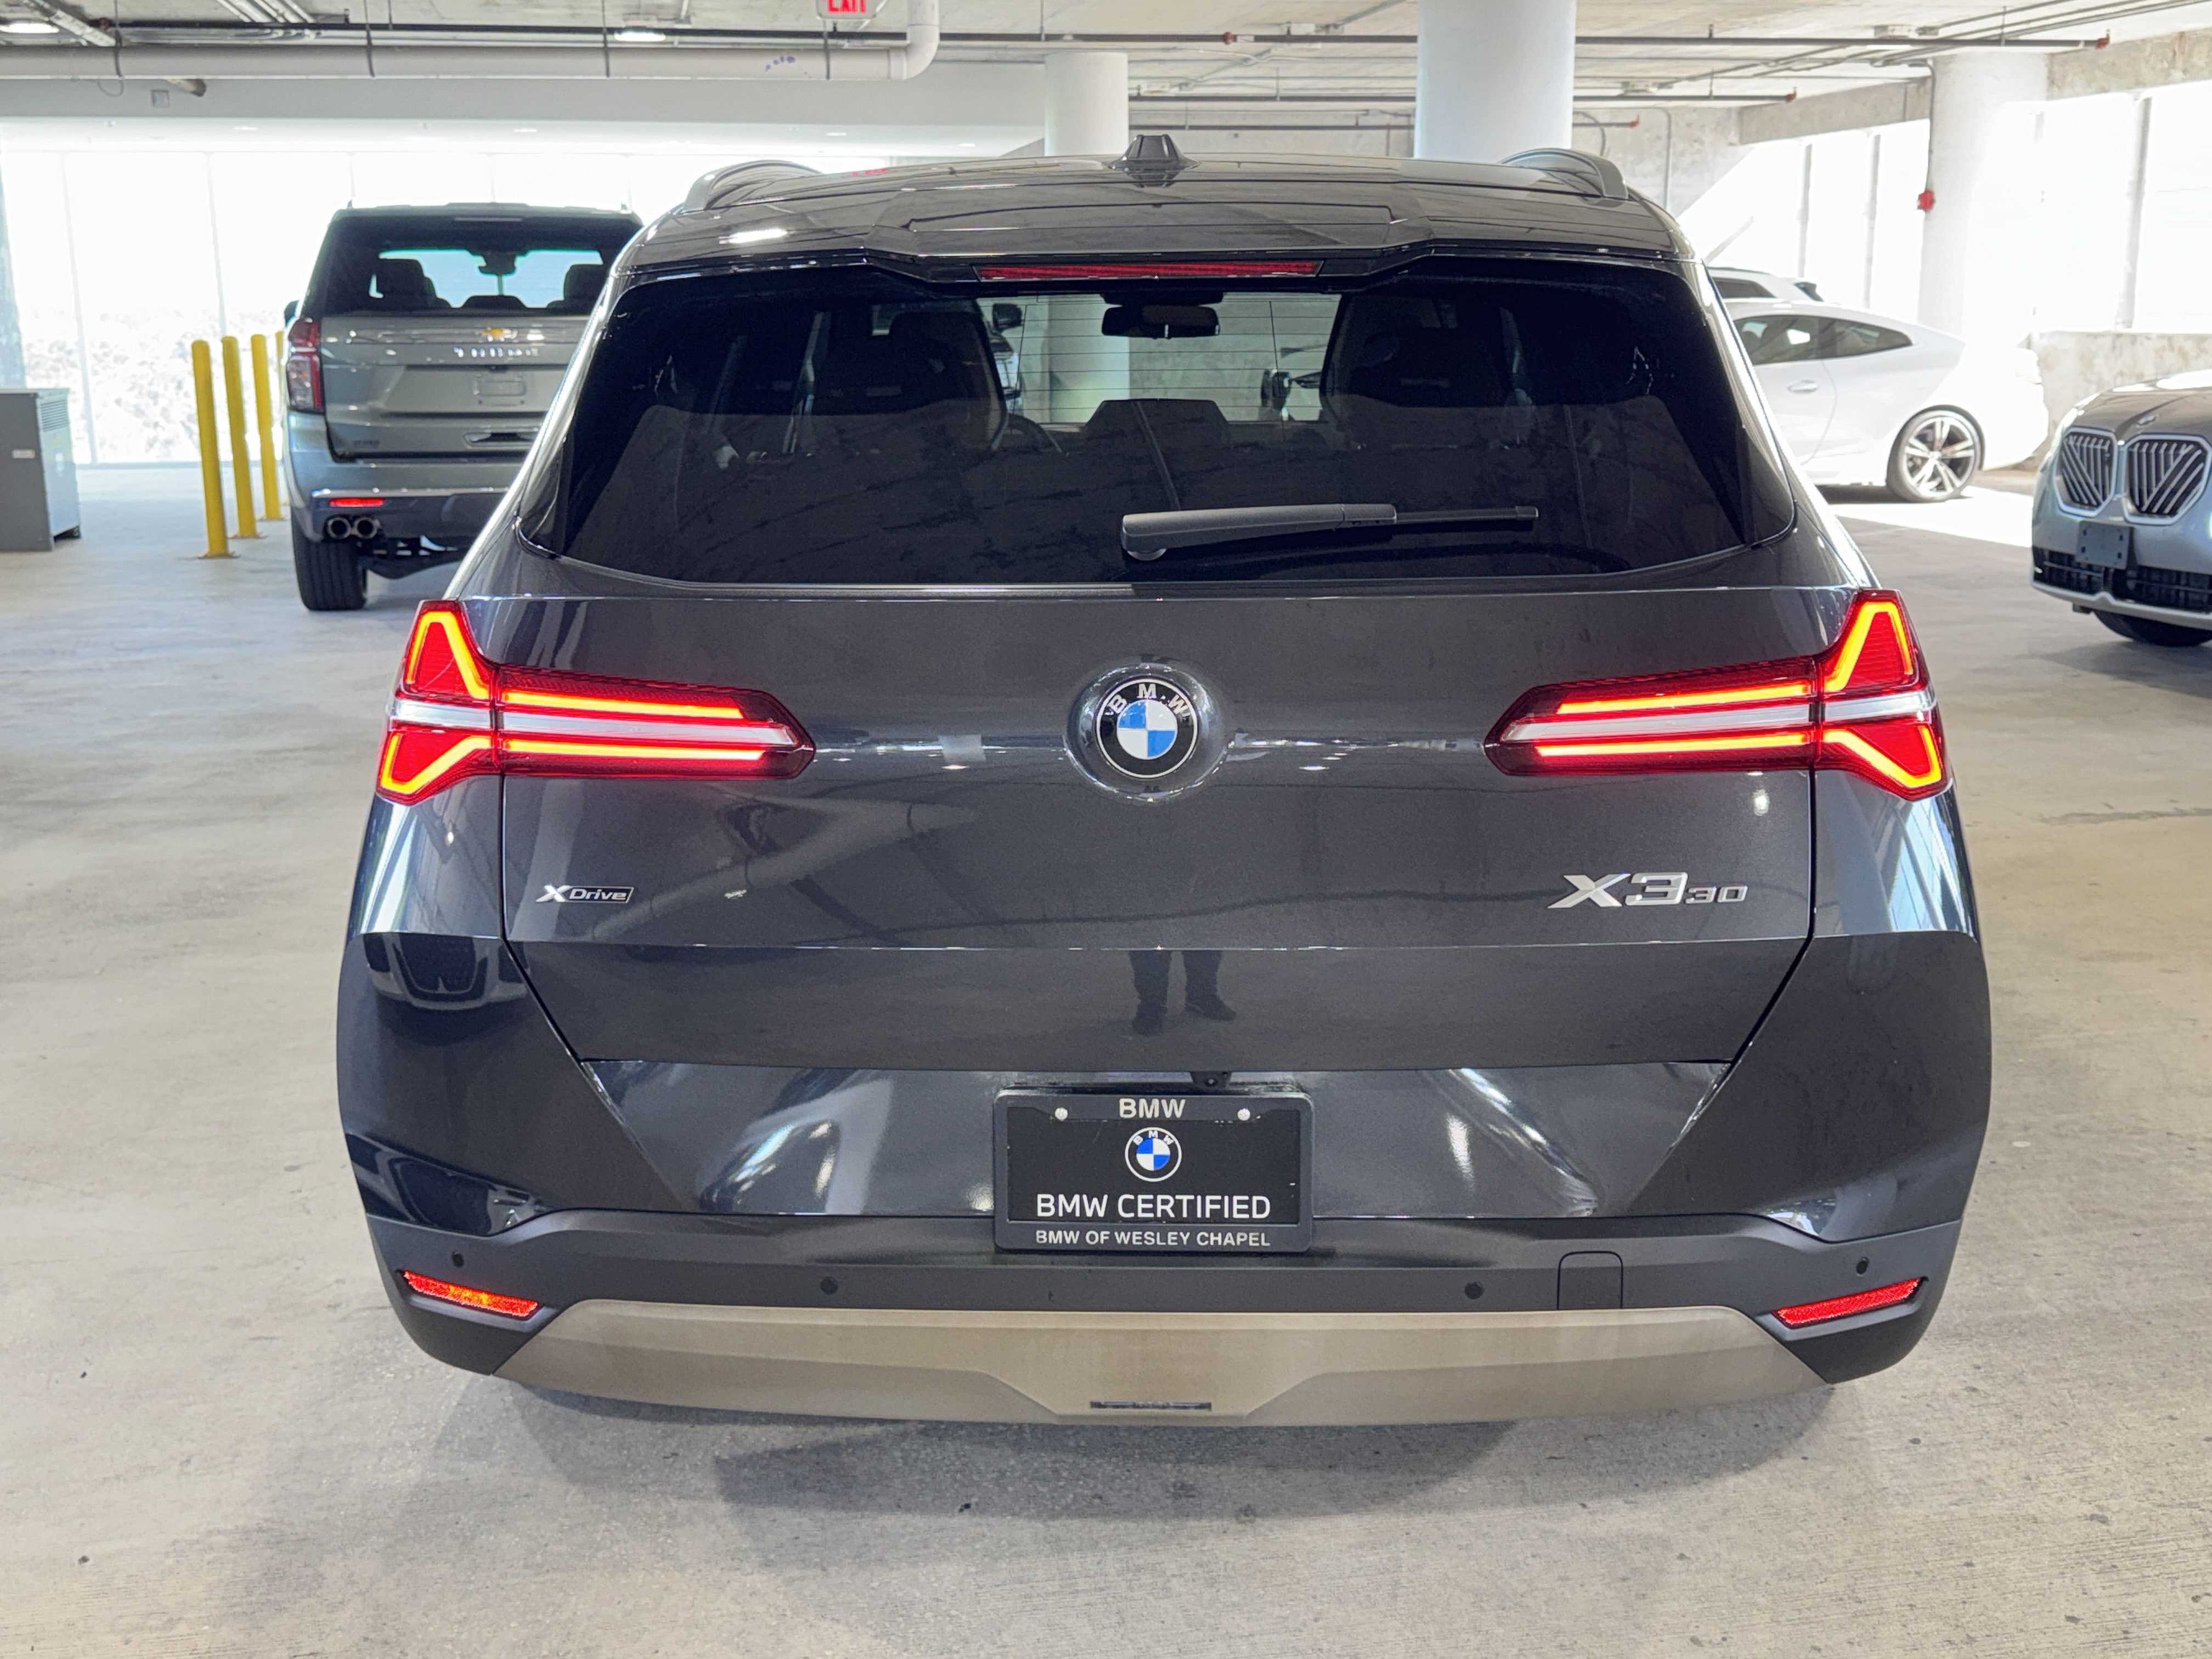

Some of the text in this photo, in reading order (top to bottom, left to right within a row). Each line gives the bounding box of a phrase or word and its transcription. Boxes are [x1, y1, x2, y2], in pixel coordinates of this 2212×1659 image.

[1105, 684, 1190, 718] BMW
[1119, 1098, 1186, 1119] BMW
[1132, 1130, 1174, 1146] BMW
[1036, 1194, 1271, 1218] BMW CERTIFIED
[1036, 1231, 1271, 1246] BMW OF WESLEY CHAPEL
